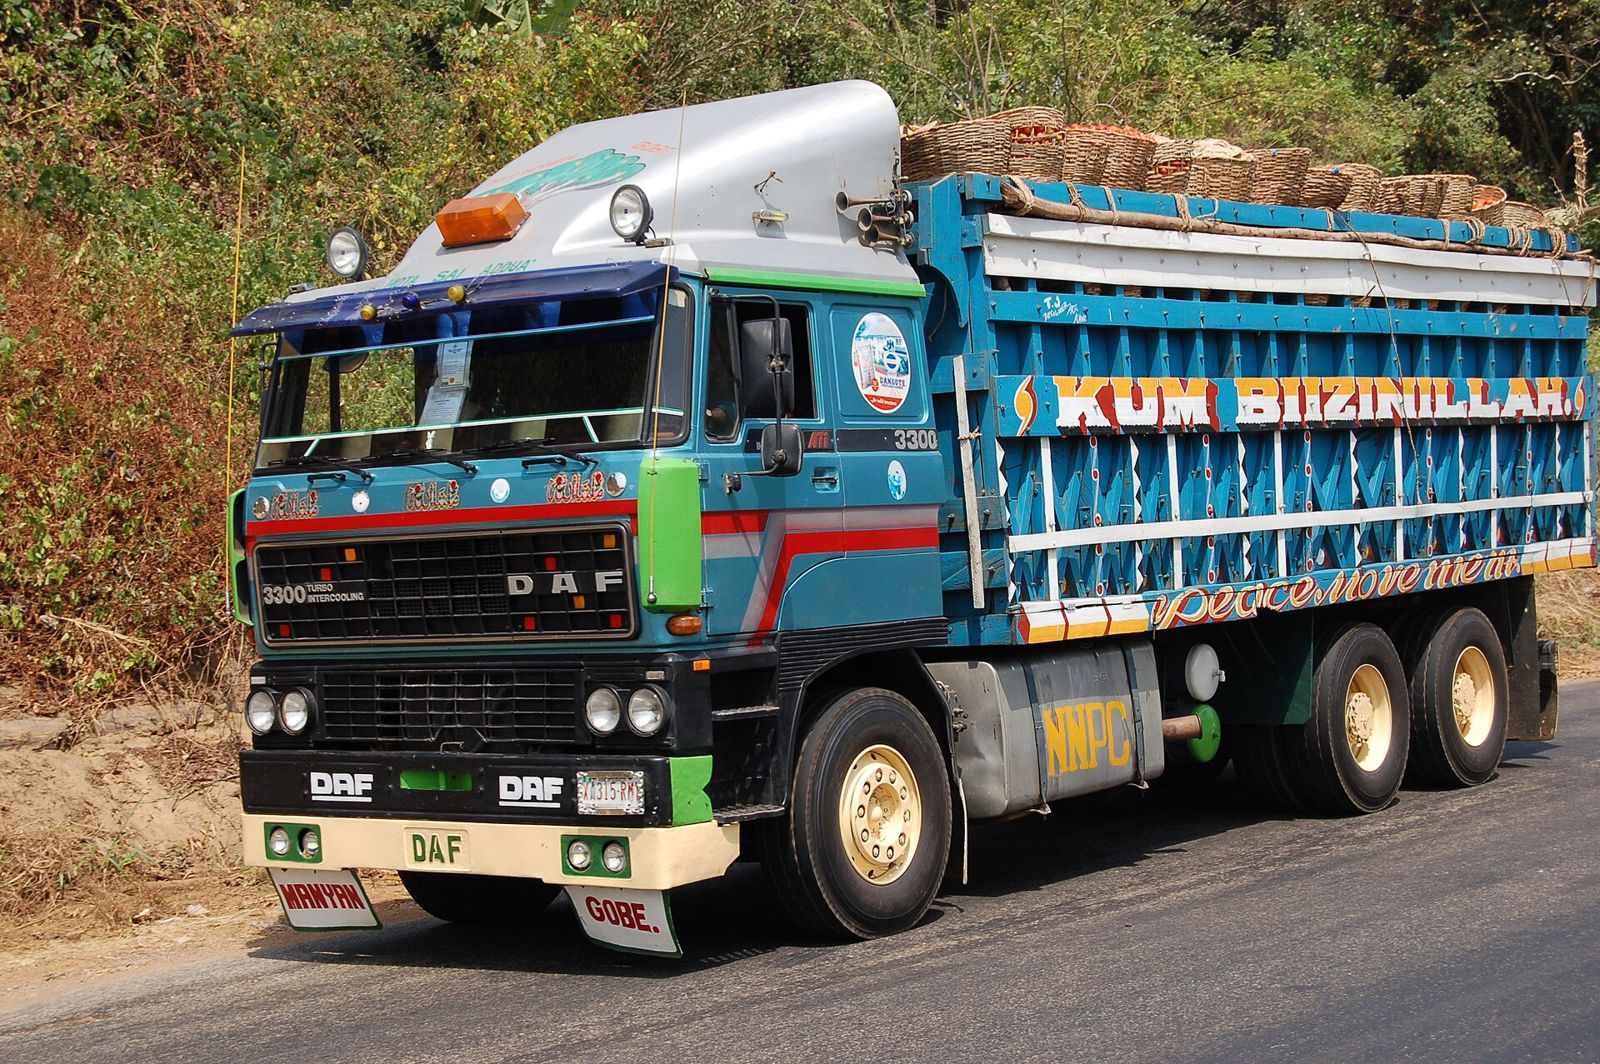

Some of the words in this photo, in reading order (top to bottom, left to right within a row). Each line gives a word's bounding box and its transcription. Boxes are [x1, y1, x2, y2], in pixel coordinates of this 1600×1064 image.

[1053, 376, 1209, 428] KUM
[894, 429, 938, 450] 3300
[263, 585, 306, 605] 3300
[306, 583, 333, 592] TURBO
[507, 571, 623, 596] DAF
[307, 592, 364, 603] INTERCOOLING
[1043, 701, 1131, 777] NNPC
[310, 772, 374, 795] DAF
[499, 775, 564, 801] DAF
[411, 832, 462, 864] DAF
[279, 882, 366, 911] MANYAN
[585, 895, 660, 935] GOBE.
